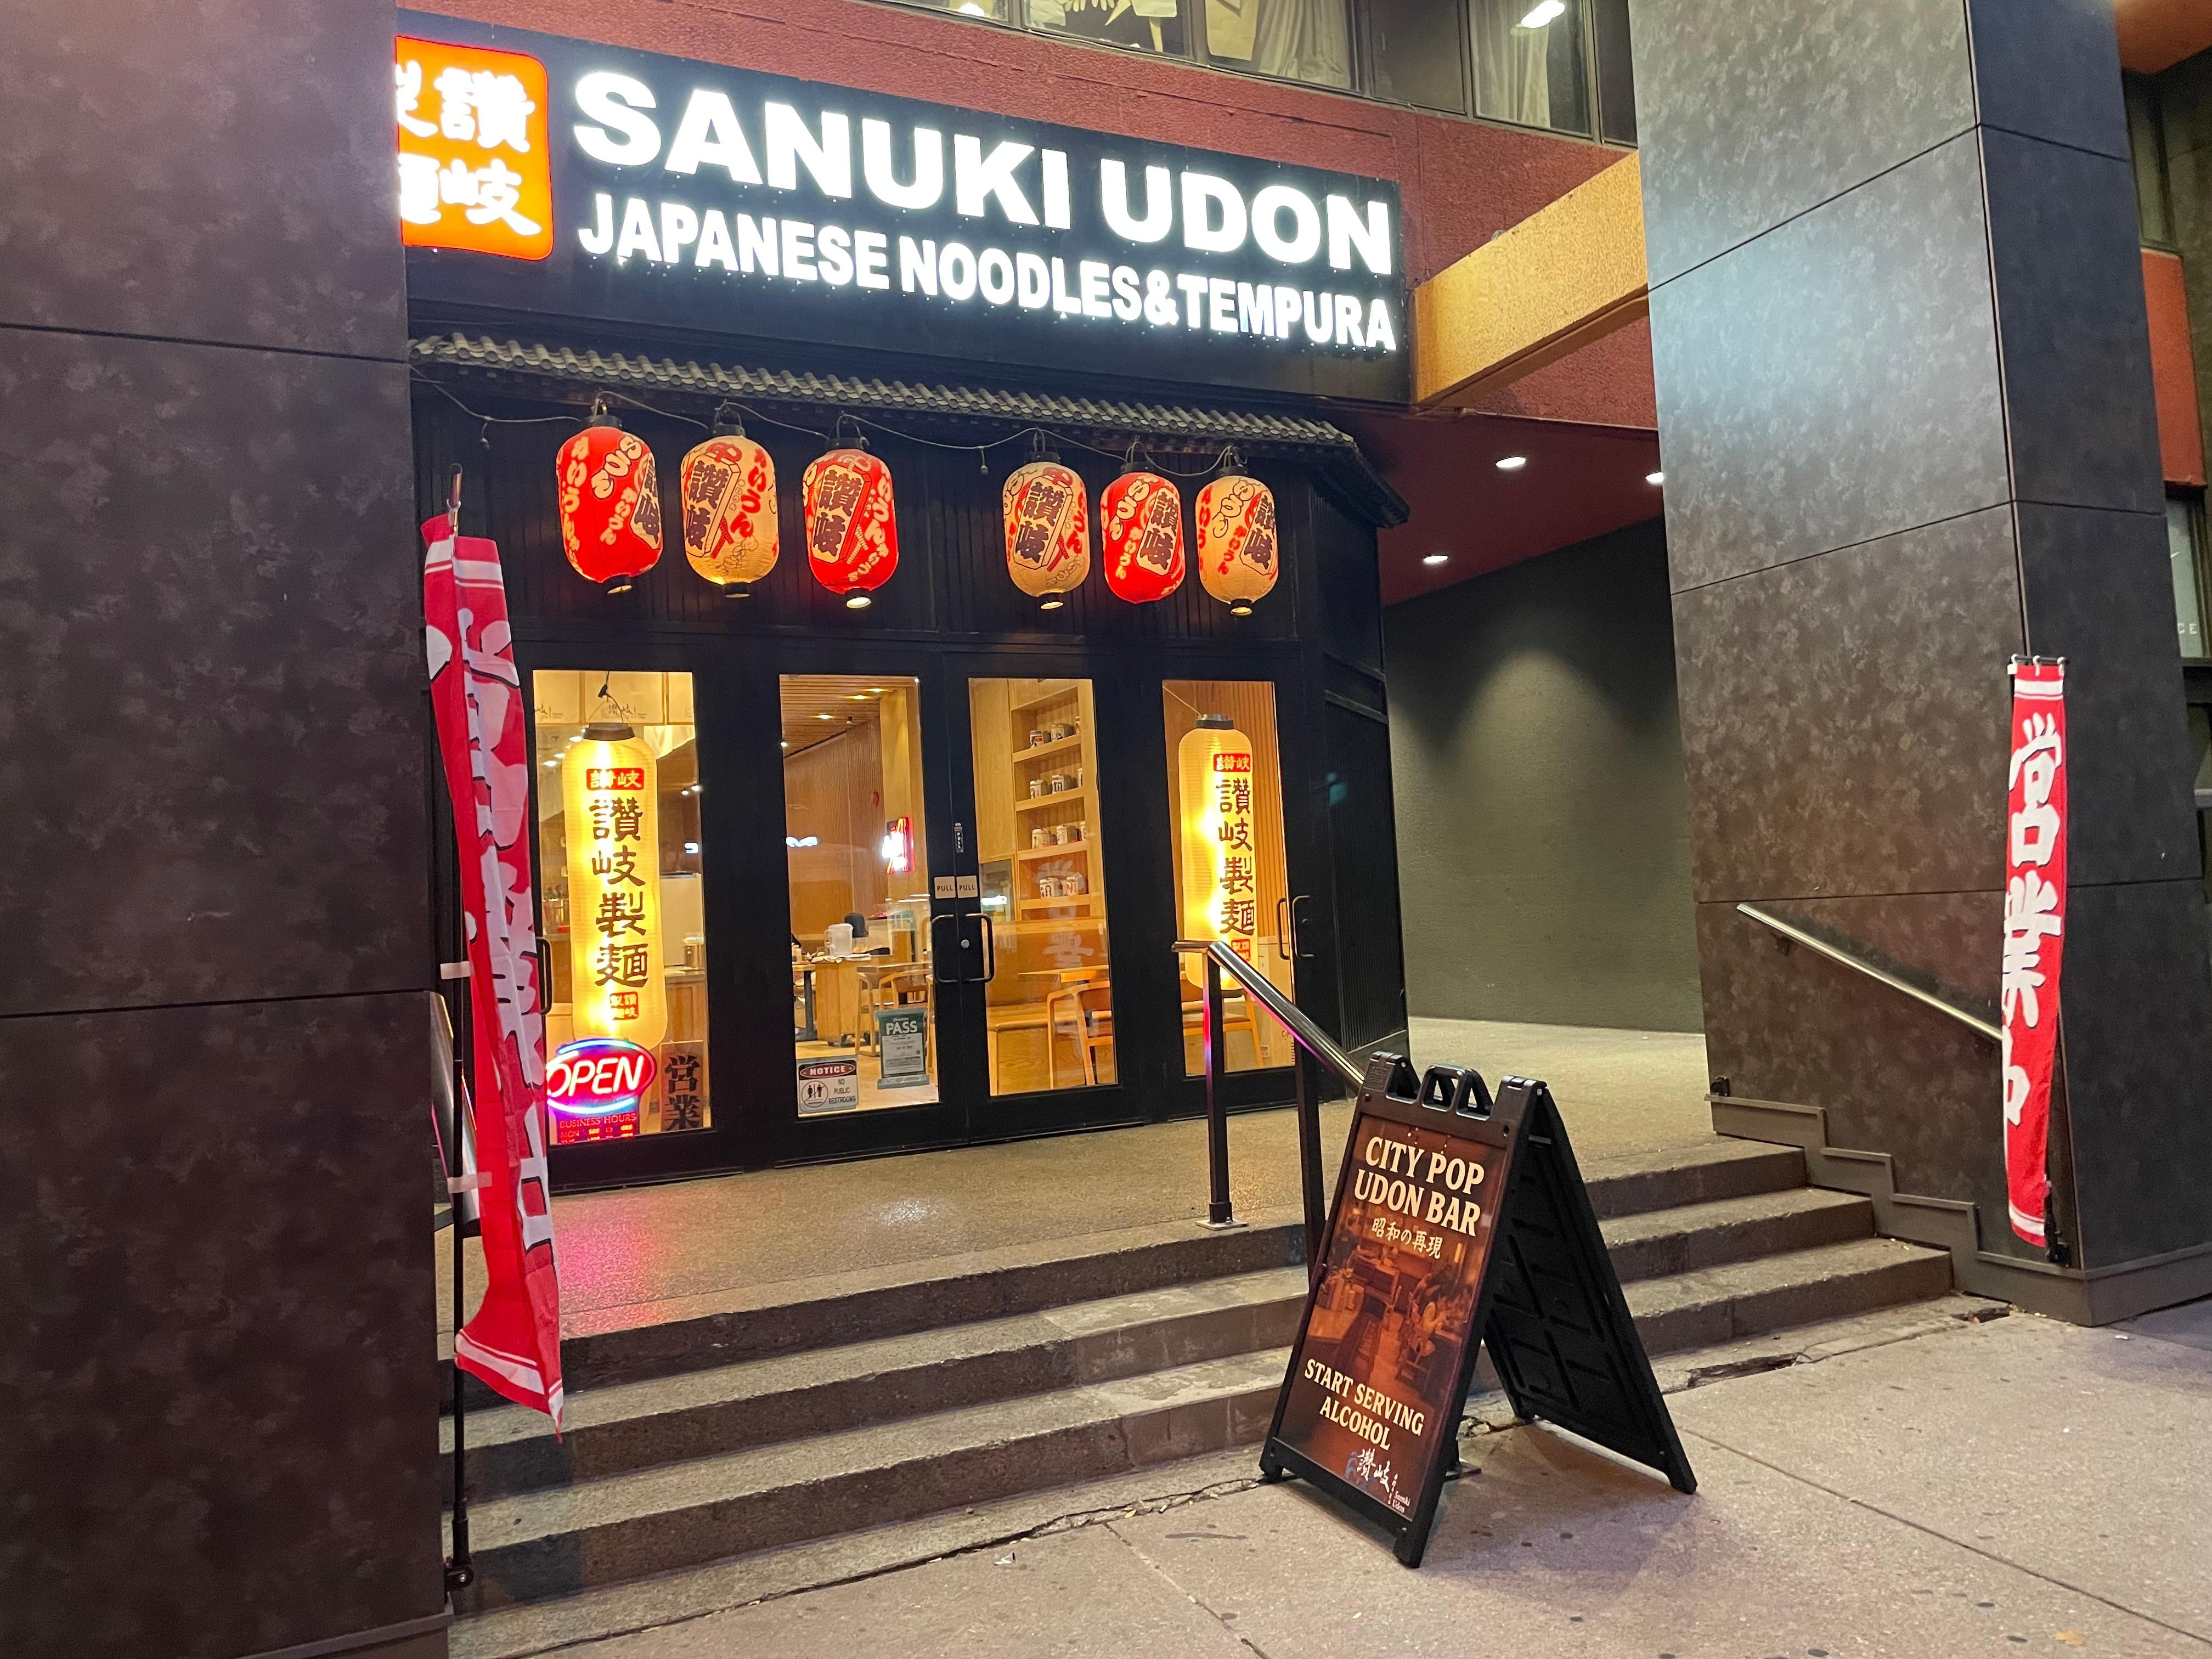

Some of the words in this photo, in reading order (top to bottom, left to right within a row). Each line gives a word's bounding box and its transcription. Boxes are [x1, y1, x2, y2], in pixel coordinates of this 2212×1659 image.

[573, 71, 1071, 230] SANUKI
[1099, 158, 1392, 275] UDON
[578, 193, 889, 290] JAPANESE
[886, 1020, 918, 1035] PASS
[546, 1050, 645, 1098] OPEN
[810, 1065, 846, 1076] NOTICE
[560, 1116, 601, 1128] BUSINESS
[603, 1113, 637, 1124] HOURS
[828, 1096, 856, 1104] RESTROOMS
[1365, 1136, 1425, 1178] CITY
[1425, 1152, 1485, 1195] POP
[1354, 1169, 1425, 1218] UDON
[1425, 1190, 1481, 1237] BAR
[1372, 1217, 1443, 1260] 昭和の再現
[1304, 1358, 1354, 1398] START
[1353, 1383, 1425, 1437] SERVING
[1319, 1396, 1391, 1451] ALCOHOL
